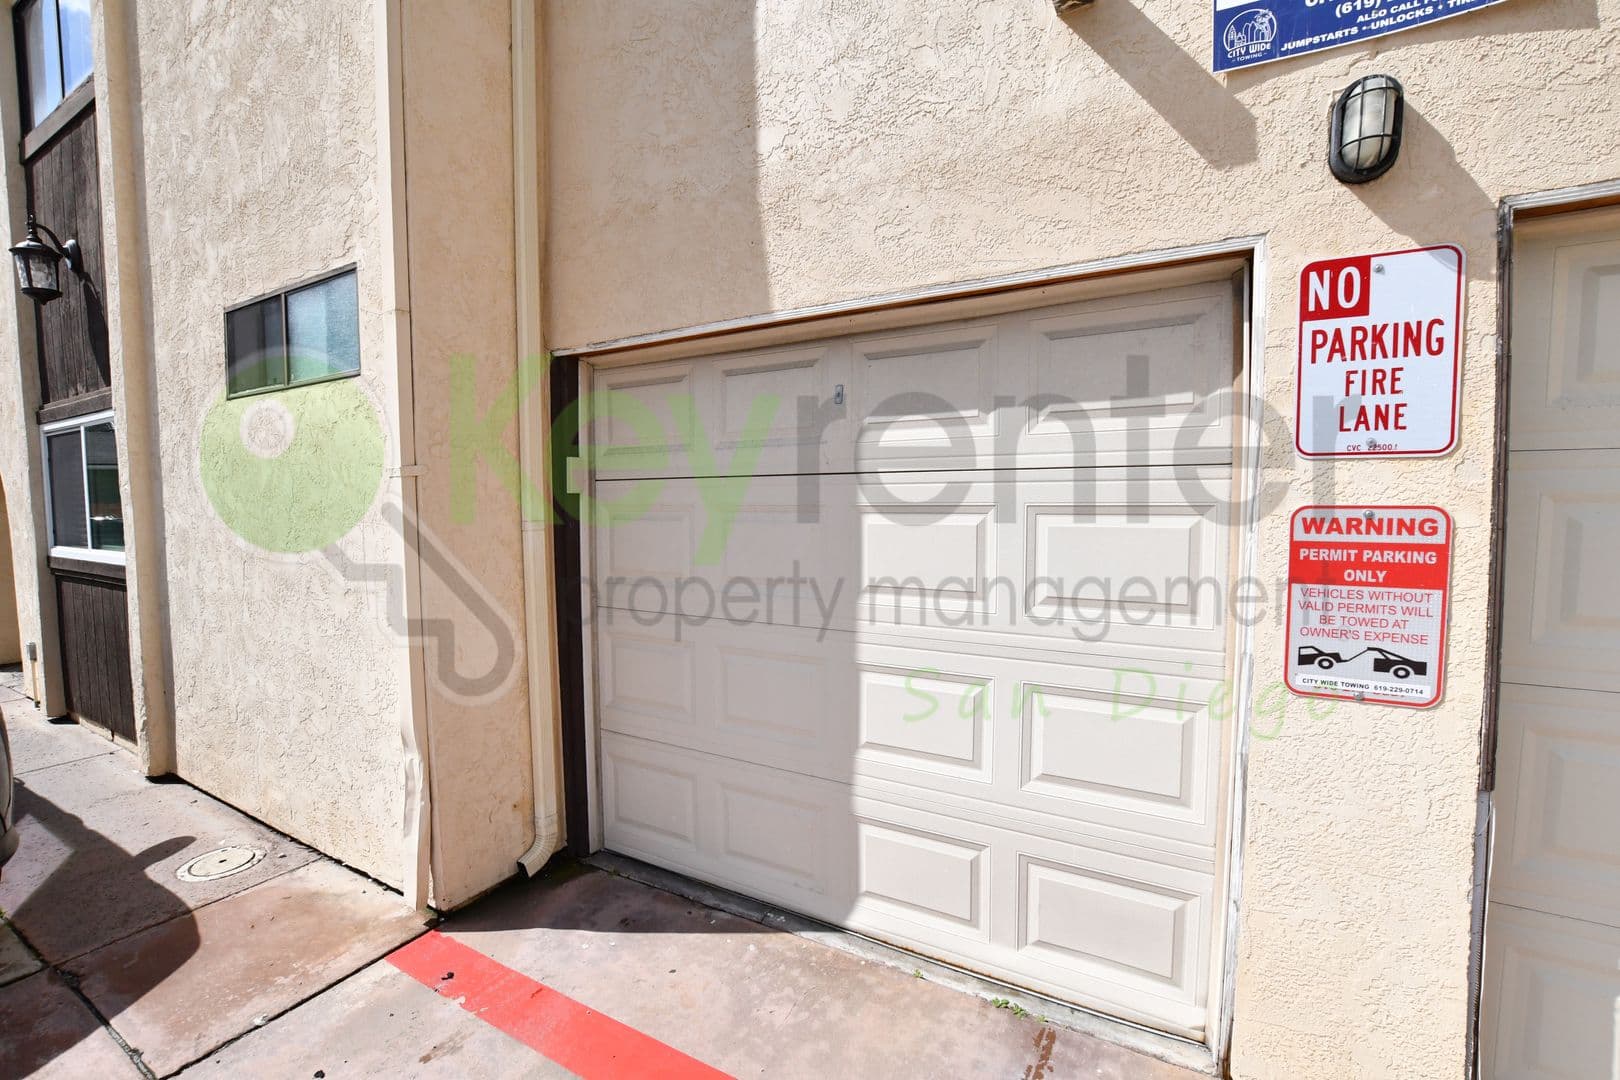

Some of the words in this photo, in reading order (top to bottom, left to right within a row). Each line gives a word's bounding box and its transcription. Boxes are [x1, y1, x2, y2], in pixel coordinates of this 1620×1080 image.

[1356, 9, 1387, 23] ALSO
[1390, 0, 1421, 13] CALL
[1281, 26, 1359, 51] JUMPSTARTS
[1371, 6, 1433, 29] UNLOCKS
[1227, 46, 1246, 58] CITY
[1249, 43, 1271, 53] WIDE
[1236, 52, 1262, 61] TOWING
[1308, 266, 1361, 312] NO
[1310, 318, 1445, 364] PARKING
[1344, 367, 1404, 397] FIRE
[1339, 403, 1408, 432] LANE
[1301, 517, 1439, 536] WARNING
[1299, 548, 1358, 562] PERMIT
[1362, 550, 1437, 564] PARKING
[1343, 569, 1387, 583] ONLY
[1301, 587, 1364, 600] VEHICLES
[1368, 590, 1434, 604] WITHOUT
[1298, 601, 1334, 612] VALID
[1338, 603, 1397, 616] PERMITS
[1400, 606, 1433, 618] WILL
[1319, 615, 1335, 625] BE
[1340, 616, 1389, 629] TOWED
[1392, 619, 1409, 630] AT
[1300, 627, 1360, 640] OWNER'S
[1364, 631, 1428, 645] EXPENSE
[1320, 679, 1338, 687] WIDE
[1341, 682, 1370, 690] TOWING
